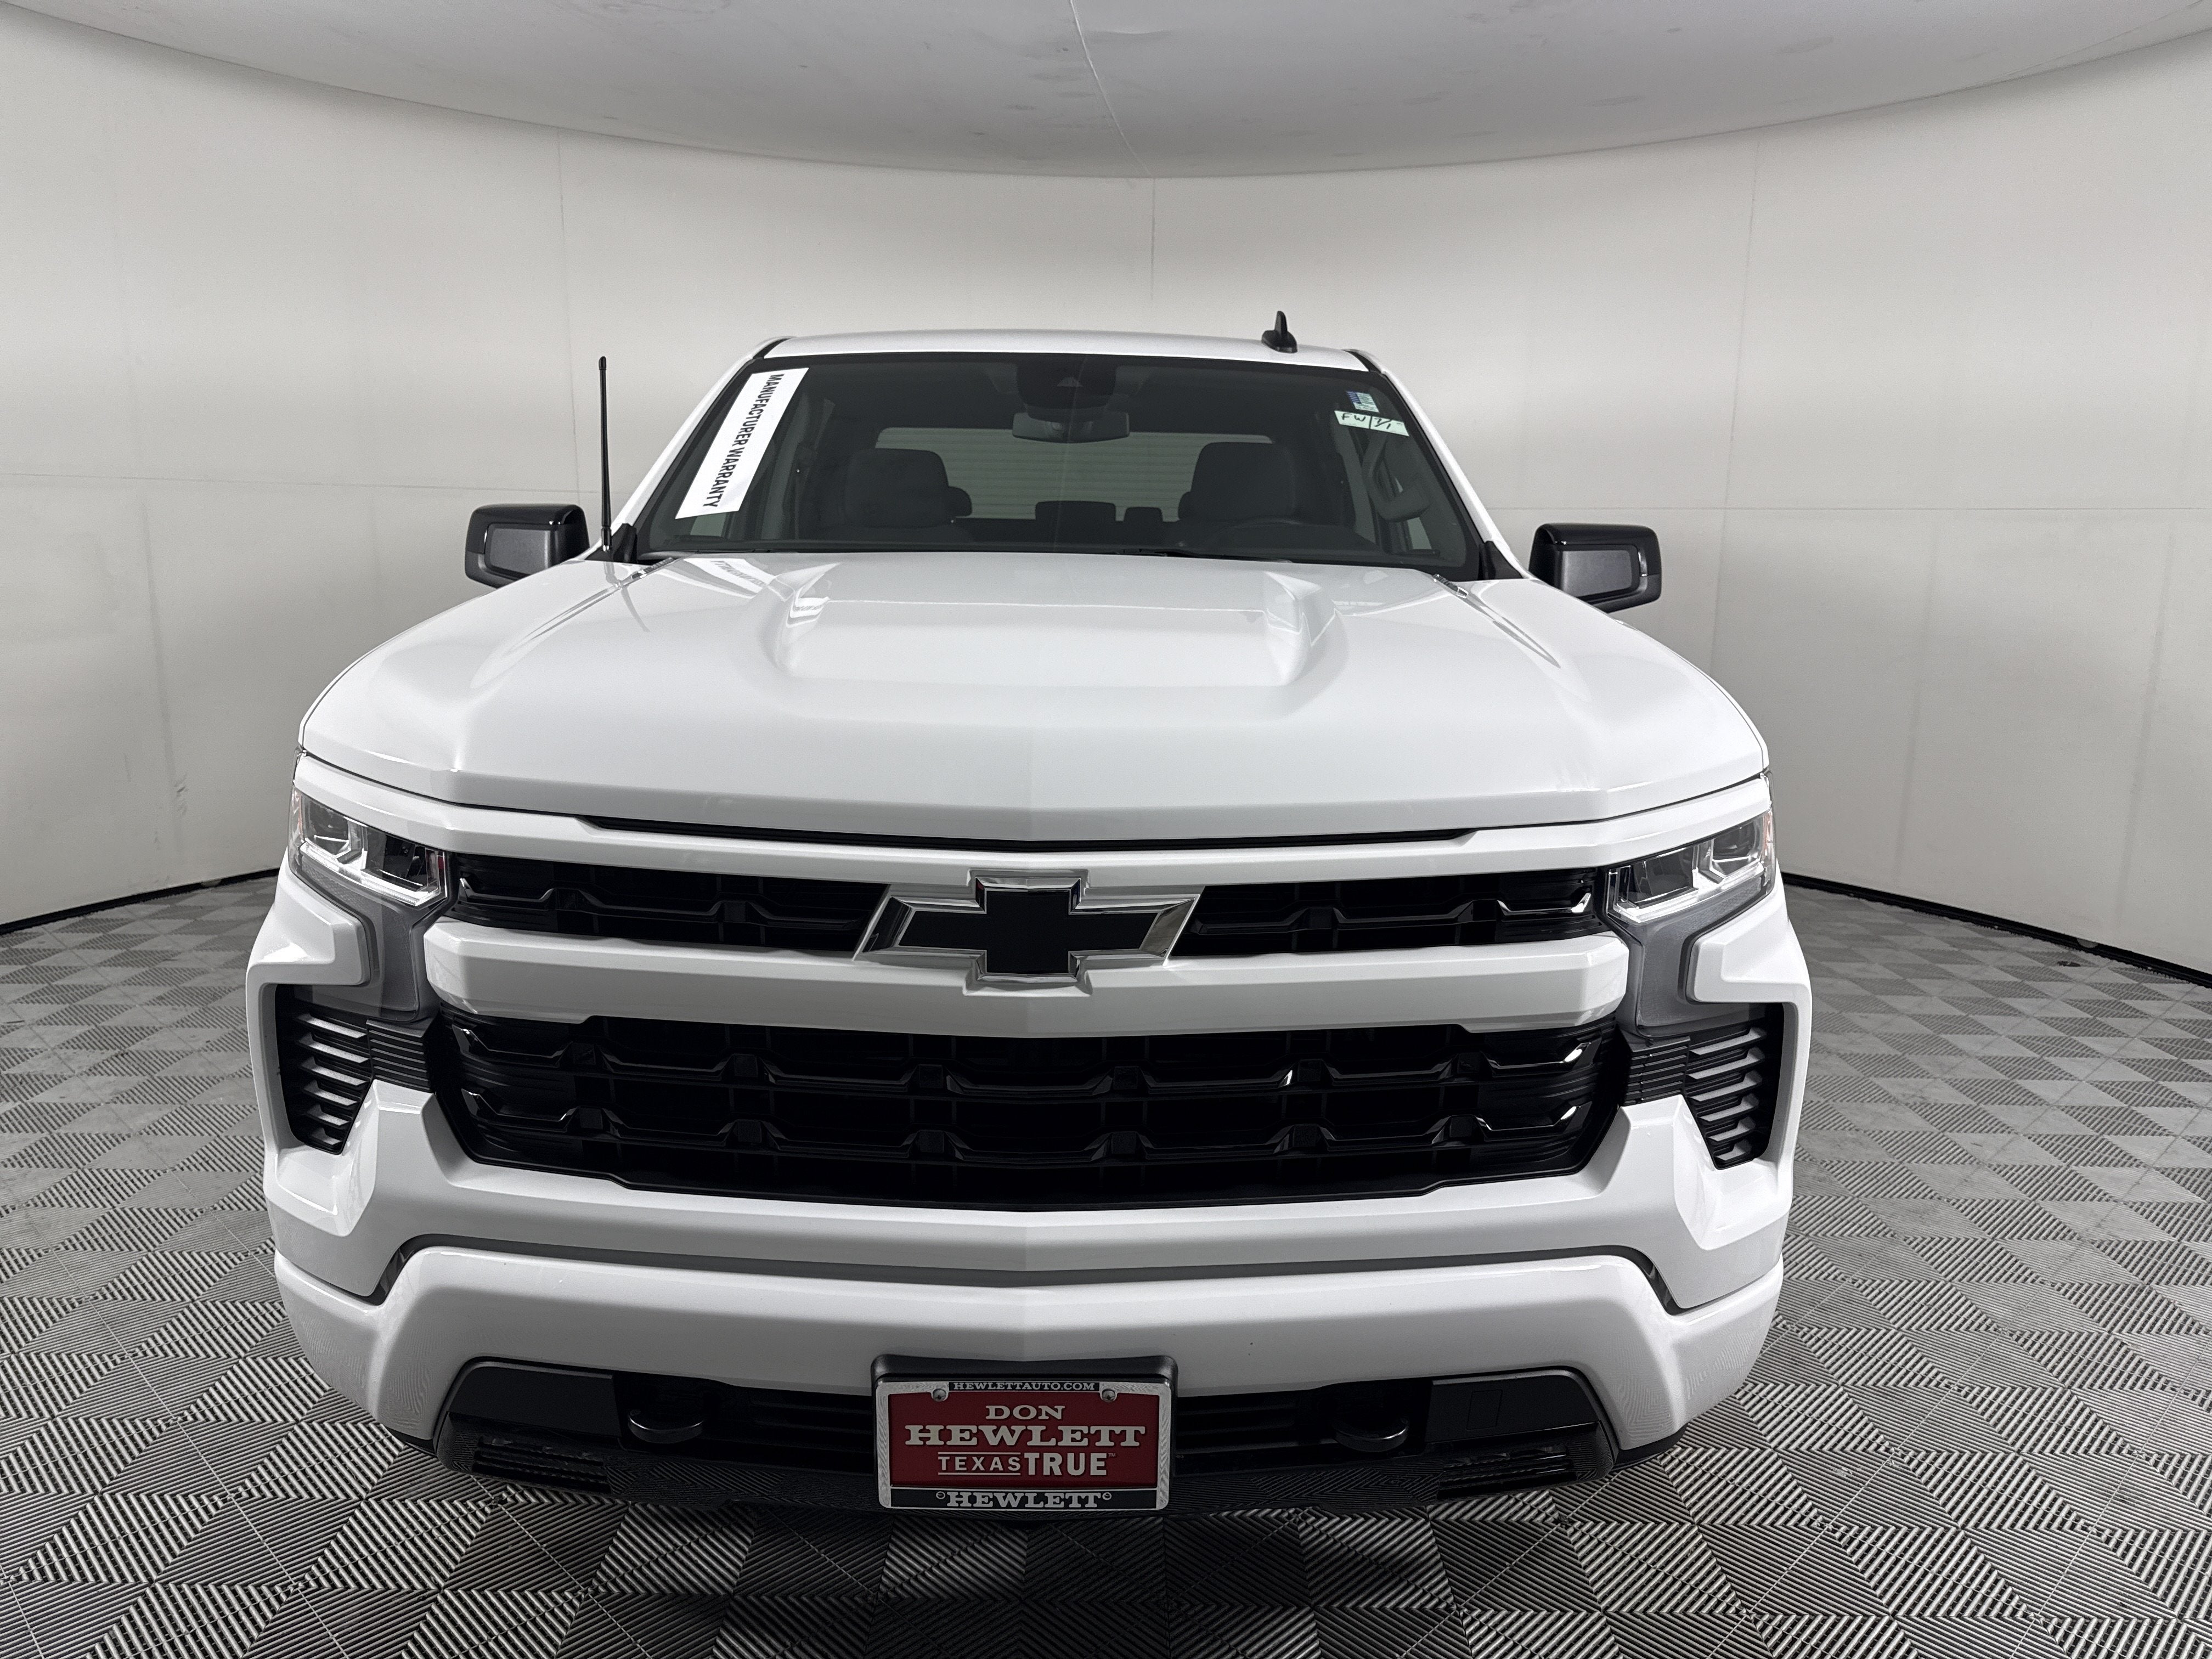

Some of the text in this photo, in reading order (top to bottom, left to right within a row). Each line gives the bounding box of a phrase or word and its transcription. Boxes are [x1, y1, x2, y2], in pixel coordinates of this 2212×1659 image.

[732, 374, 785, 447] MANUFACTURER
[703, 447, 745, 507] WARRANTY
[953, 1381, 1096, 1391] HEWLETTAUTO.COM
[986, 1405, 1065, 1420] DON
[905, 1425, 1146, 1447] HEWLETT
[946, 1492, 1102, 1508] HEWLETT
